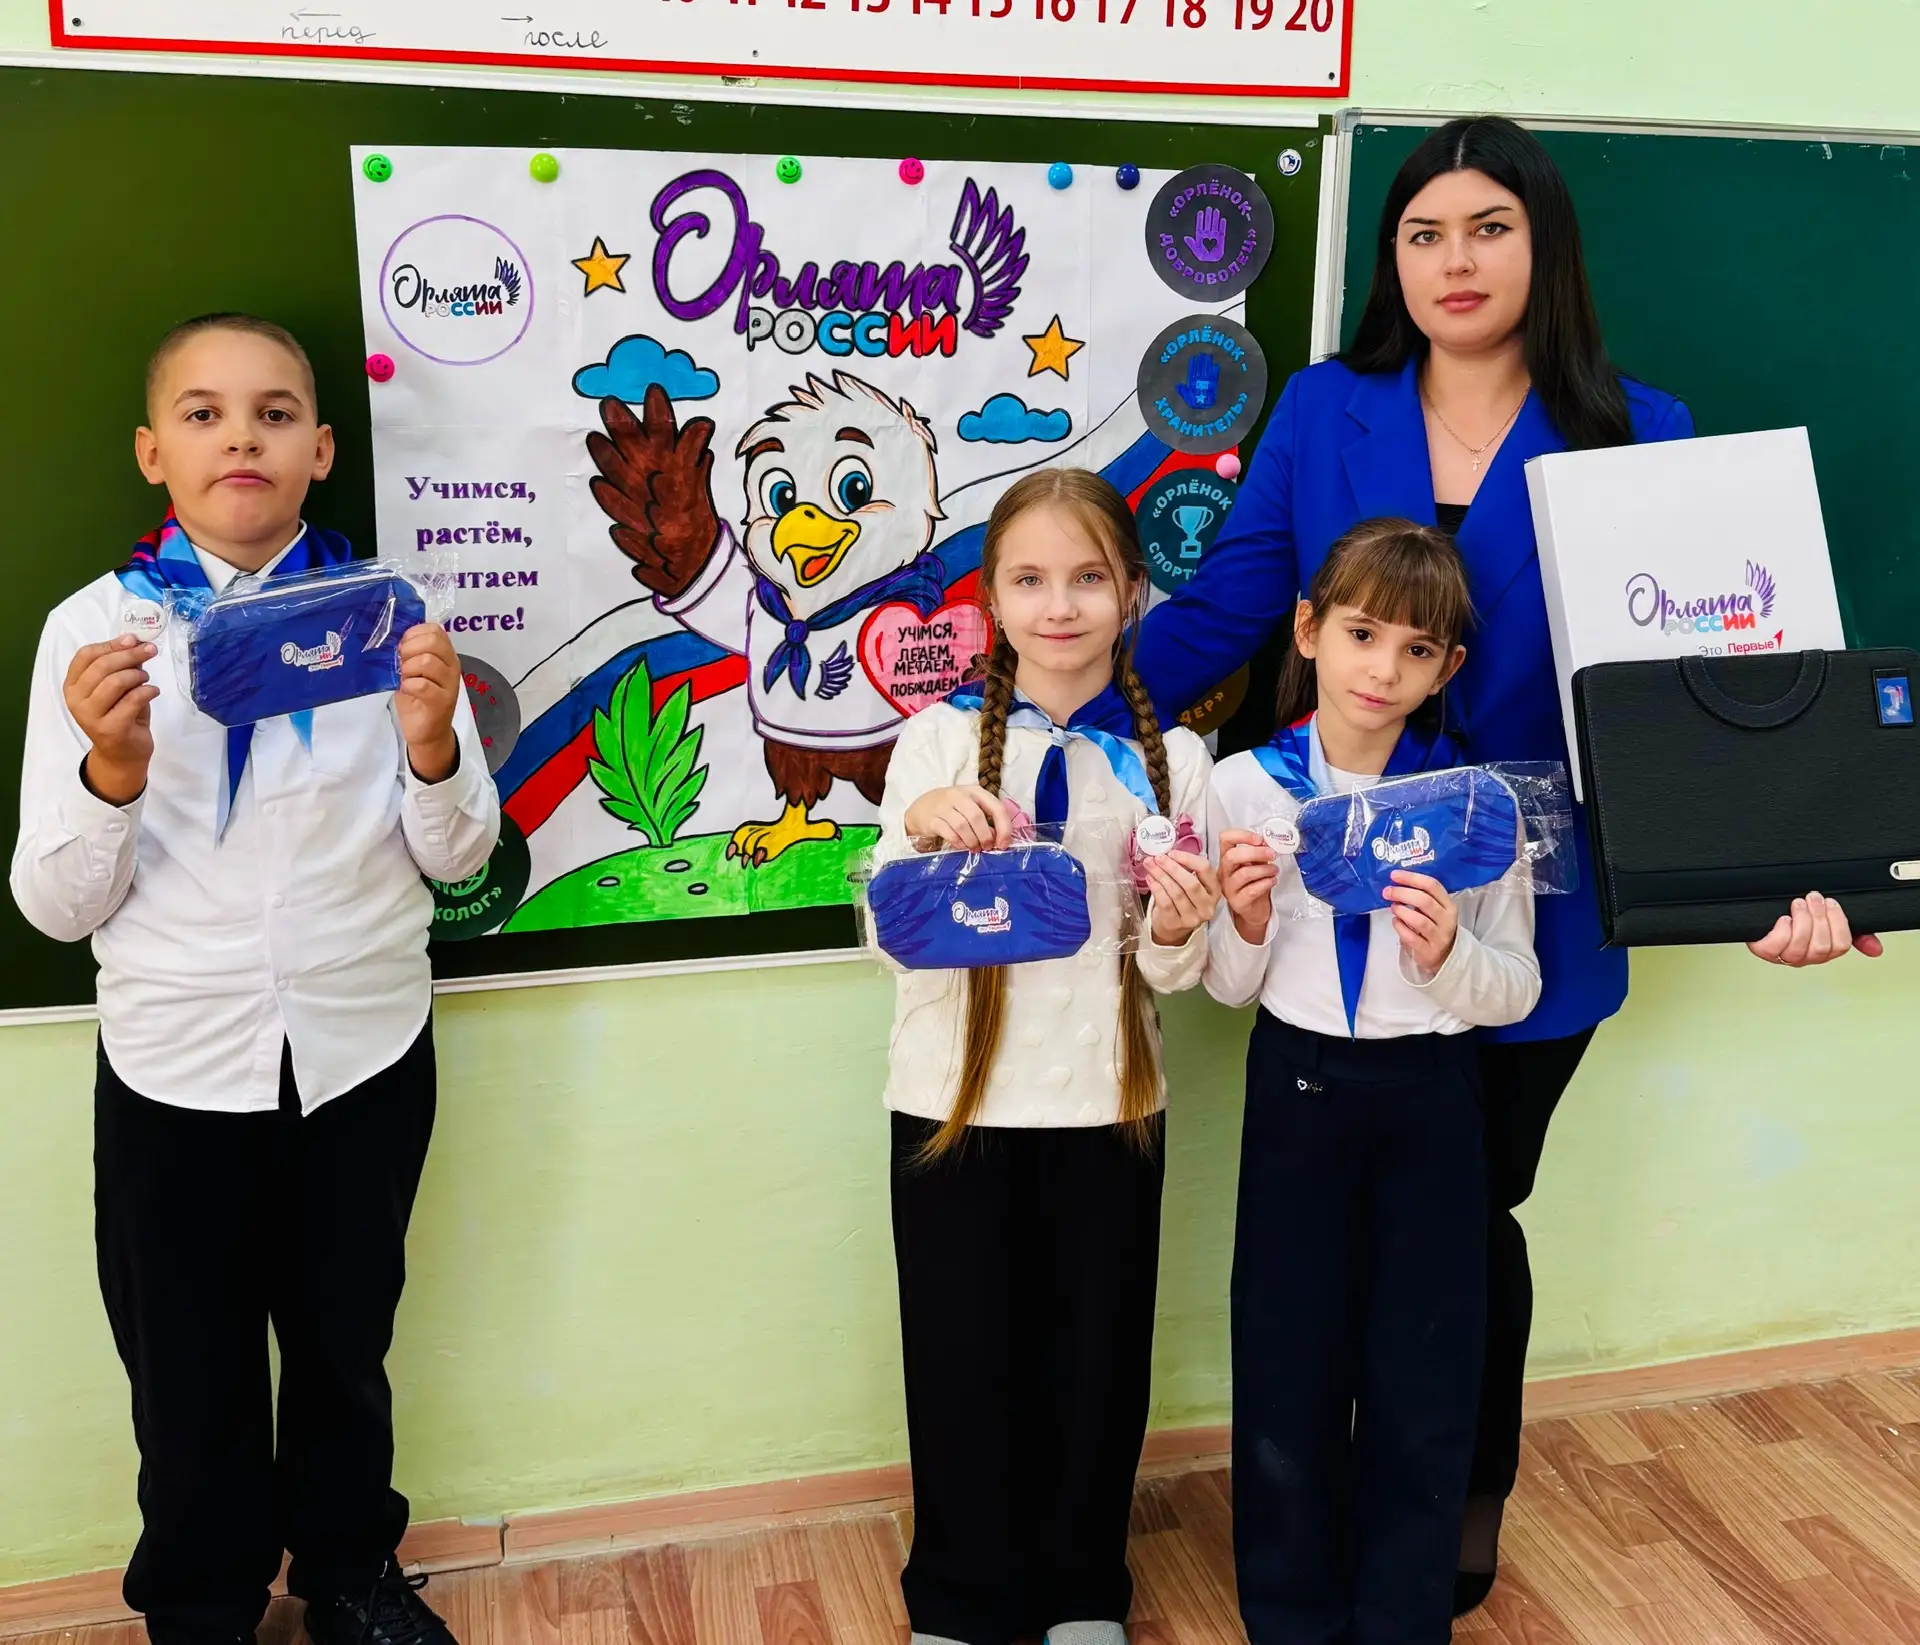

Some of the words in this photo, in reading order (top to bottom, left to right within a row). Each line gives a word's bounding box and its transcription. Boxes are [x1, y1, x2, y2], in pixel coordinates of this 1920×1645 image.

[1166, 0, 1207, 29] 18
[1235, 0, 1274, 30] 19
[1285, 0, 1334, 33] 20
[523, 30, 608, 48] после
[650, 169, 963, 335] Орлята
[392, 263, 503, 313] Орлята
[424, 300, 503, 318] РОССИИ
[747, 305, 958, 358] РОССИИ
[404, 476, 537, 504] Учимся,
[415, 520, 533, 551] растём,
[1148, 541, 1197, 581] СПОРТ
[1625, 572, 1755, 631] Орлята
[443, 606, 525, 633] есте!
[1663, 611, 1756, 637] РОССИИ
[1698, 645, 1723, 657] Это
[1727, 640, 1774, 655] Первые
